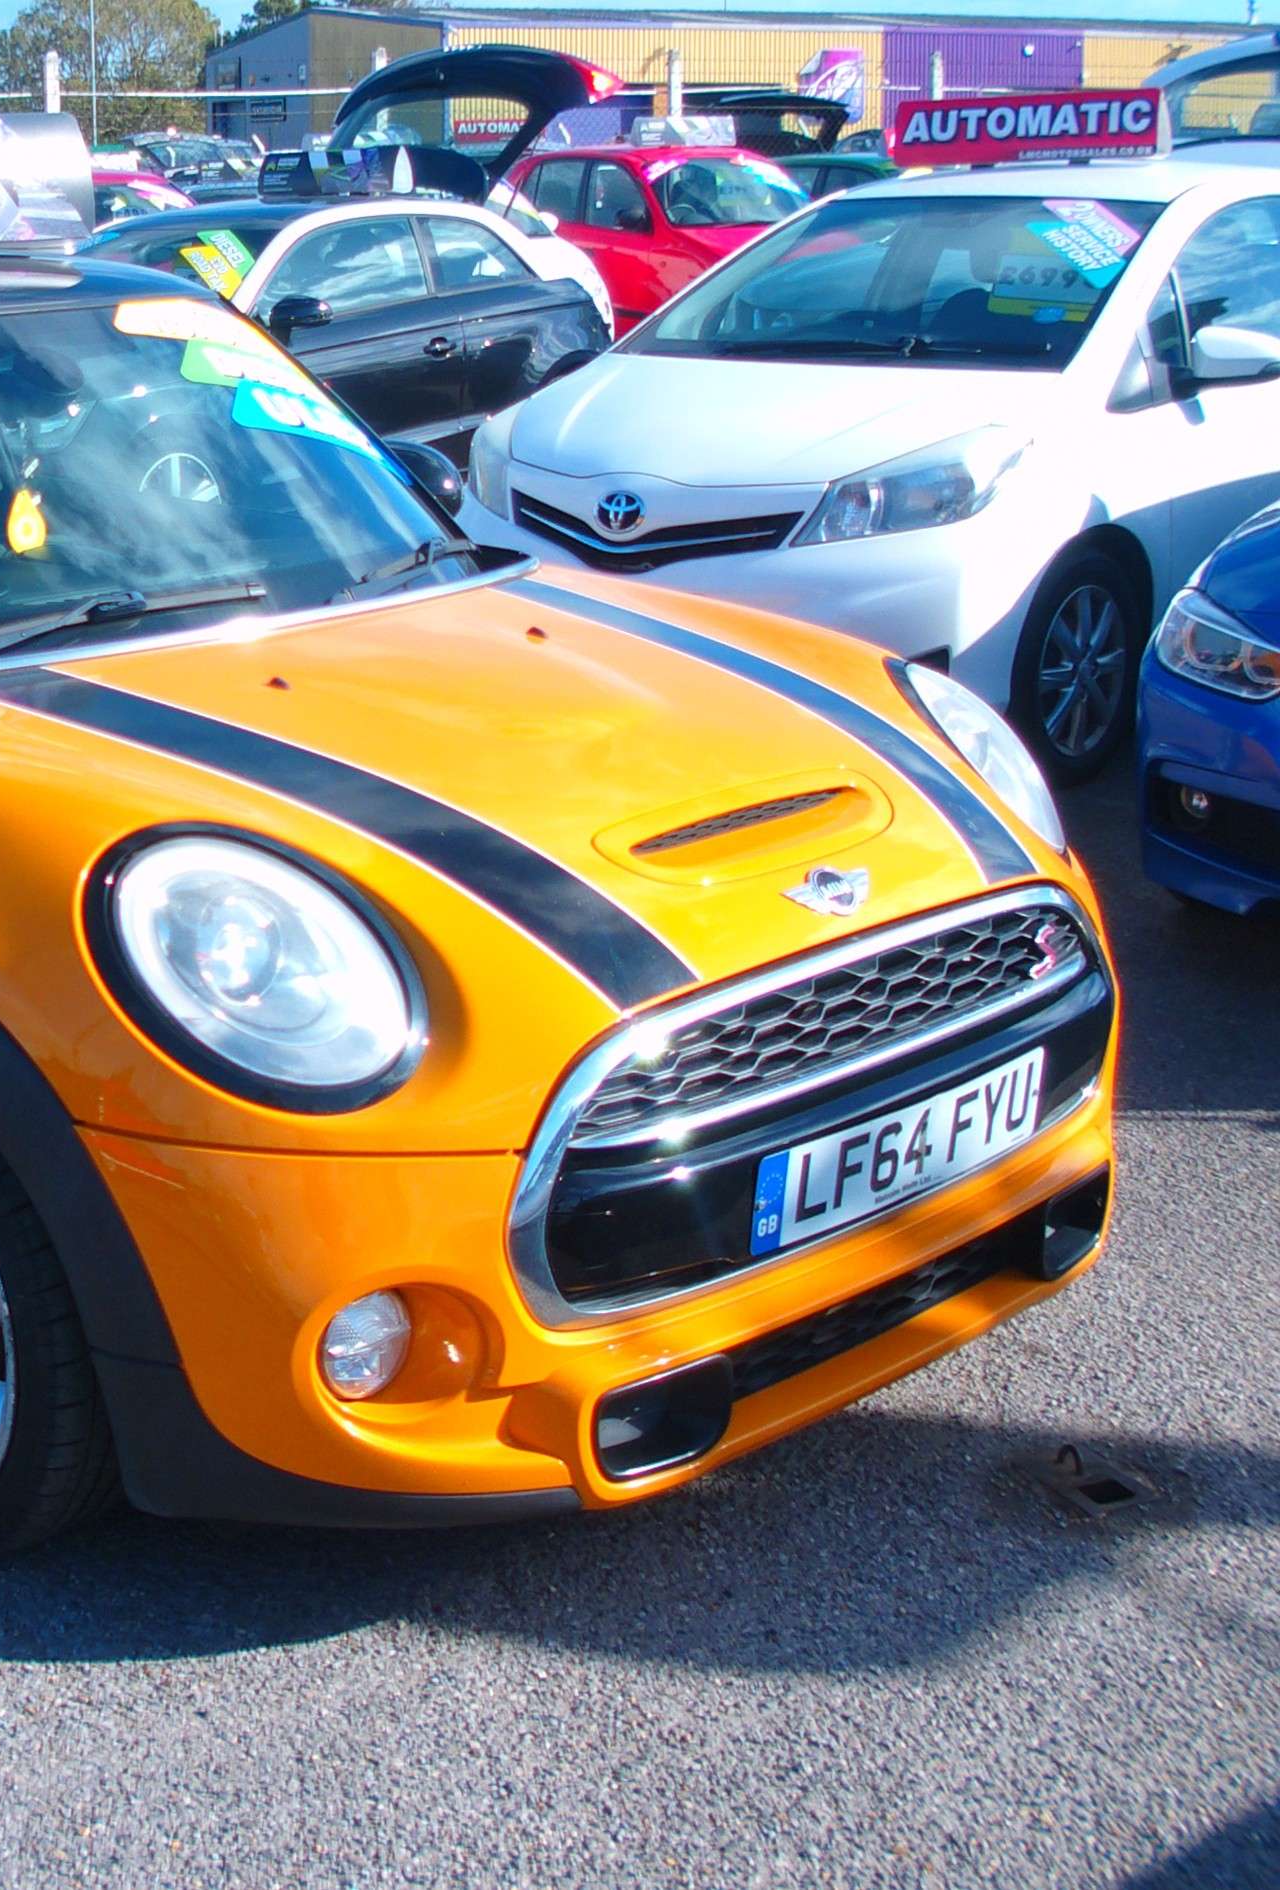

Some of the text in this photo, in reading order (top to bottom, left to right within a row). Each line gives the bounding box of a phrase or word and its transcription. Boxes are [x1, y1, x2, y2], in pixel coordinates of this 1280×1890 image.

[458, 121, 524, 134] AUTOMA
[902, 99, 1153, 144] AUTOMATIC
[209, 231, 246, 269] DIESEL
[1040, 228, 1102, 271] HISTORY
[1061, 223, 1121, 267] SERVICE
[794, 1061, 1034, 1224] LF64 FYU
[756, 1214, 778, 1238] GB
